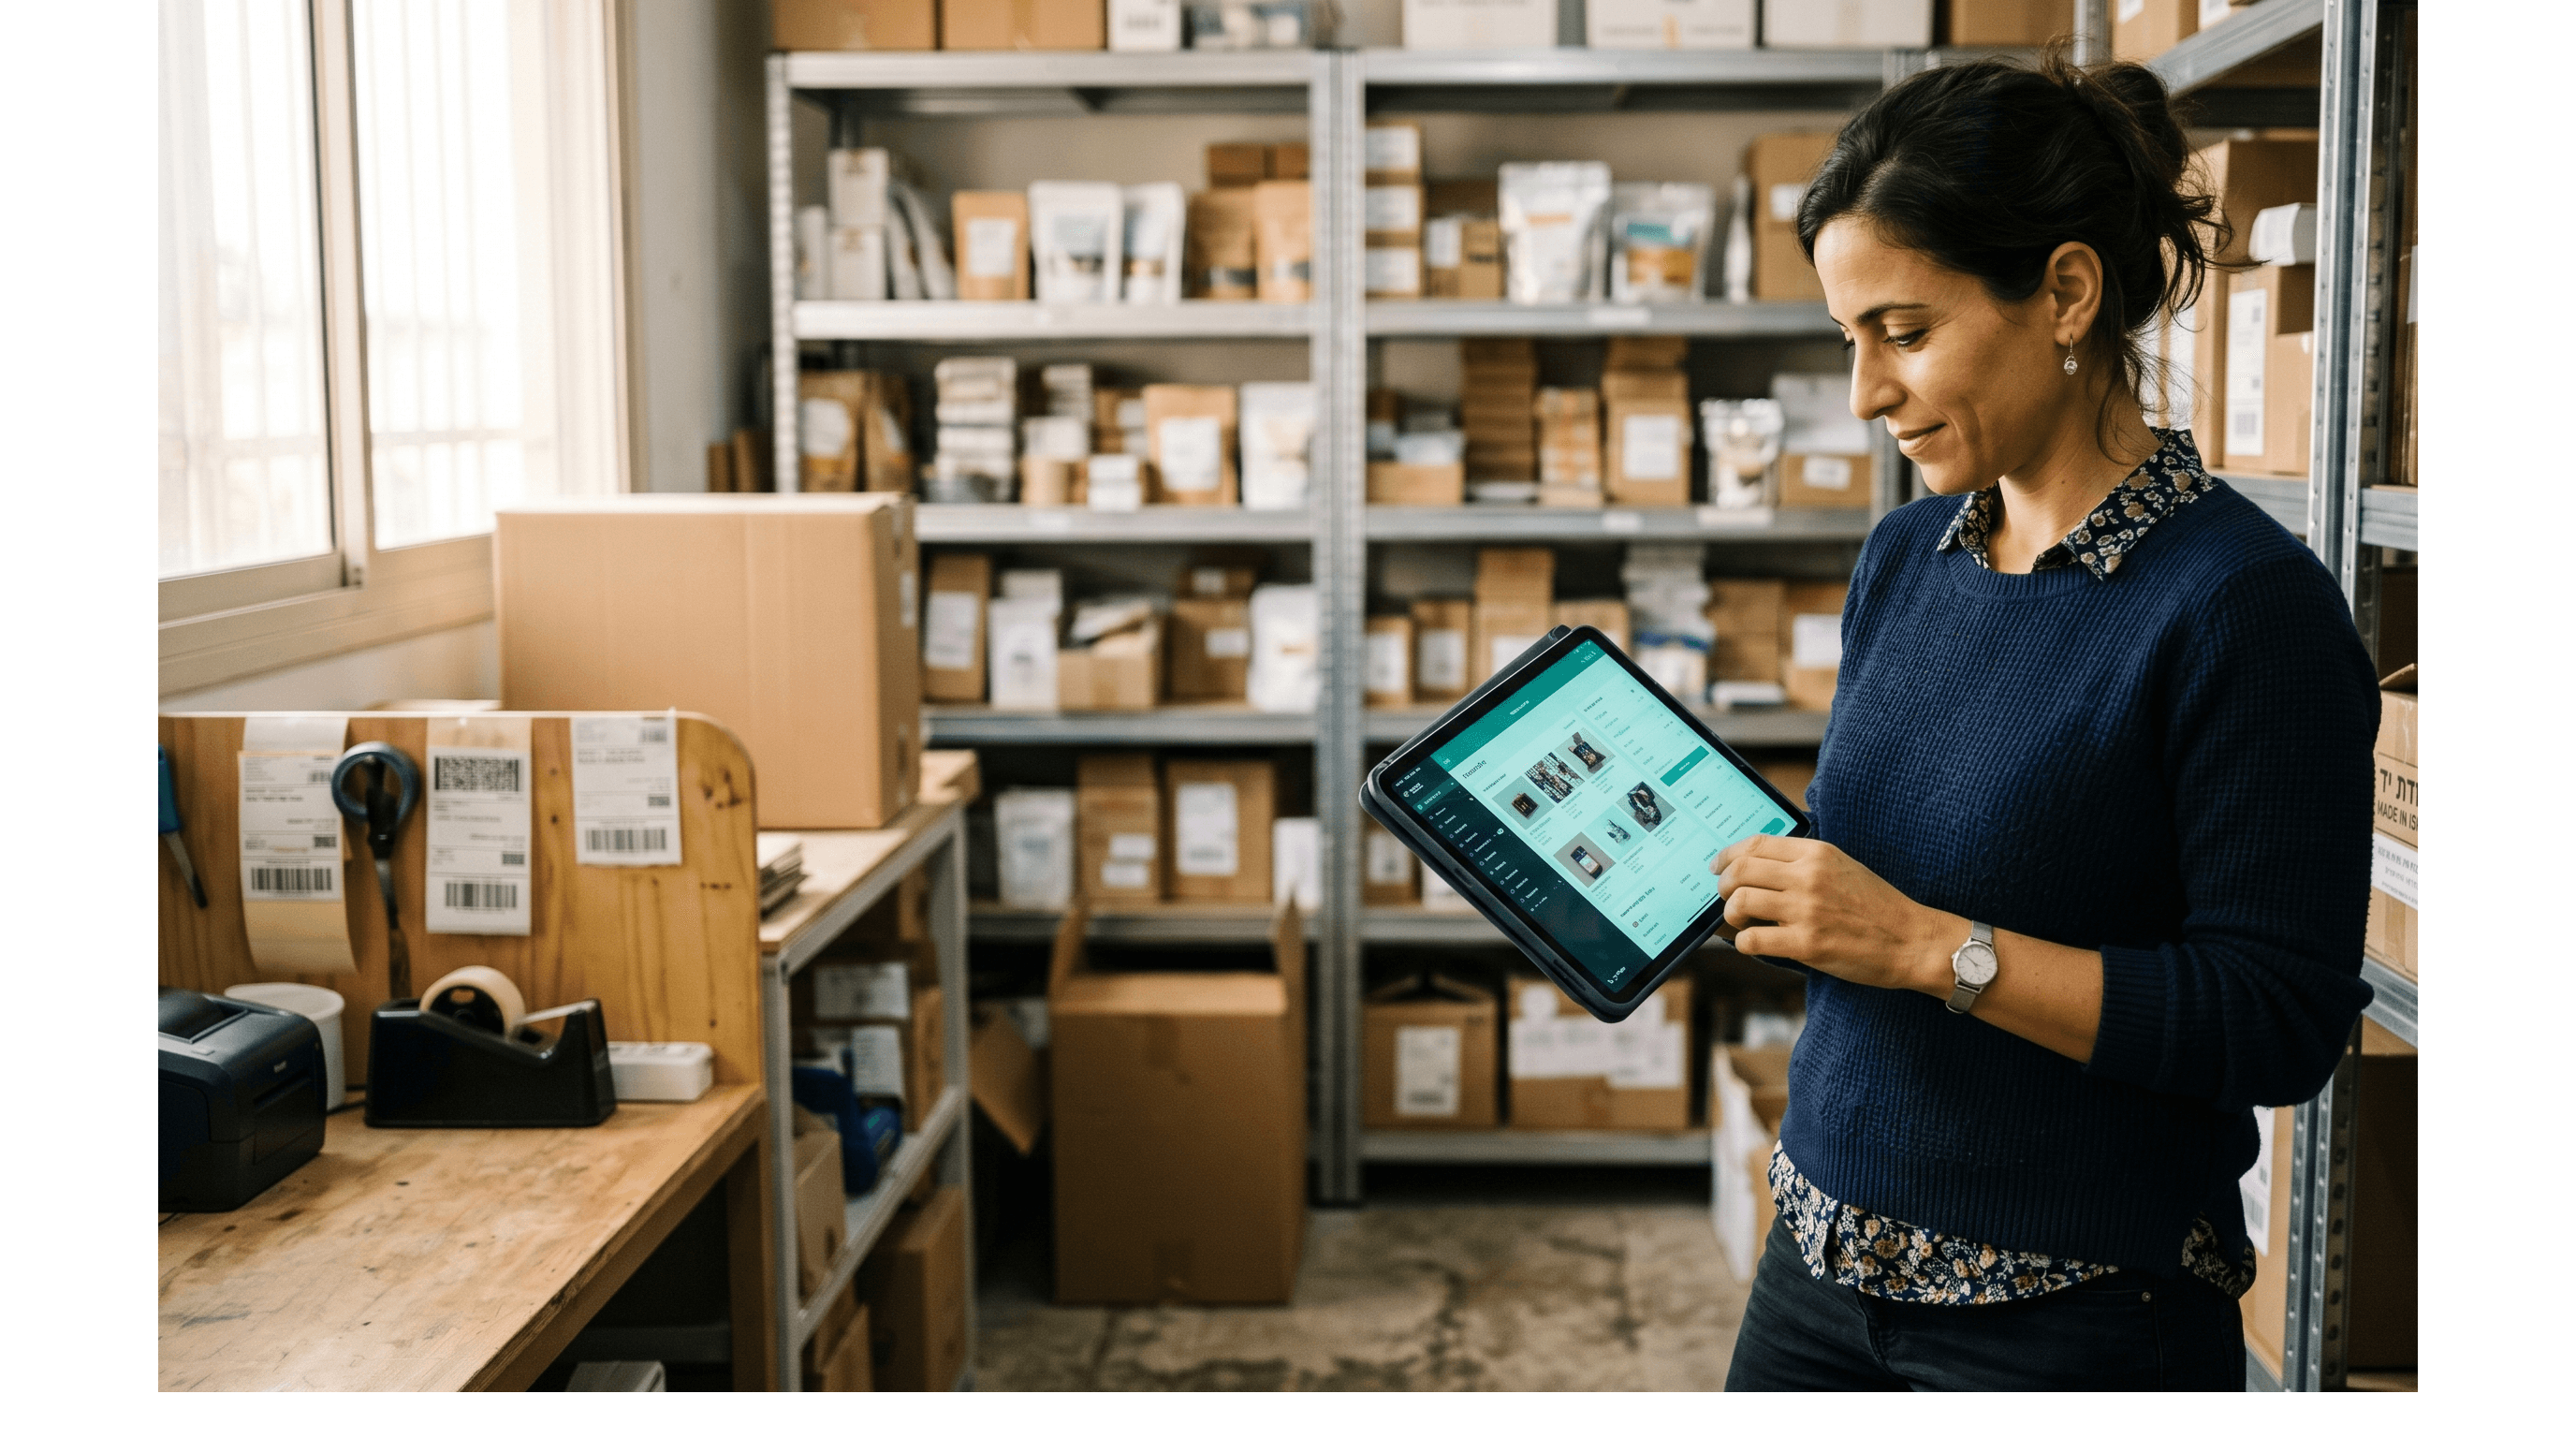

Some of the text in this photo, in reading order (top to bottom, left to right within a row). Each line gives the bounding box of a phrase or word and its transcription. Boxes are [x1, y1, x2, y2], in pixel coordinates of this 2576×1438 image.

[2379, 768, 2392, 793] יד
[2378, 800, 2418, 831] MADE IN IS
